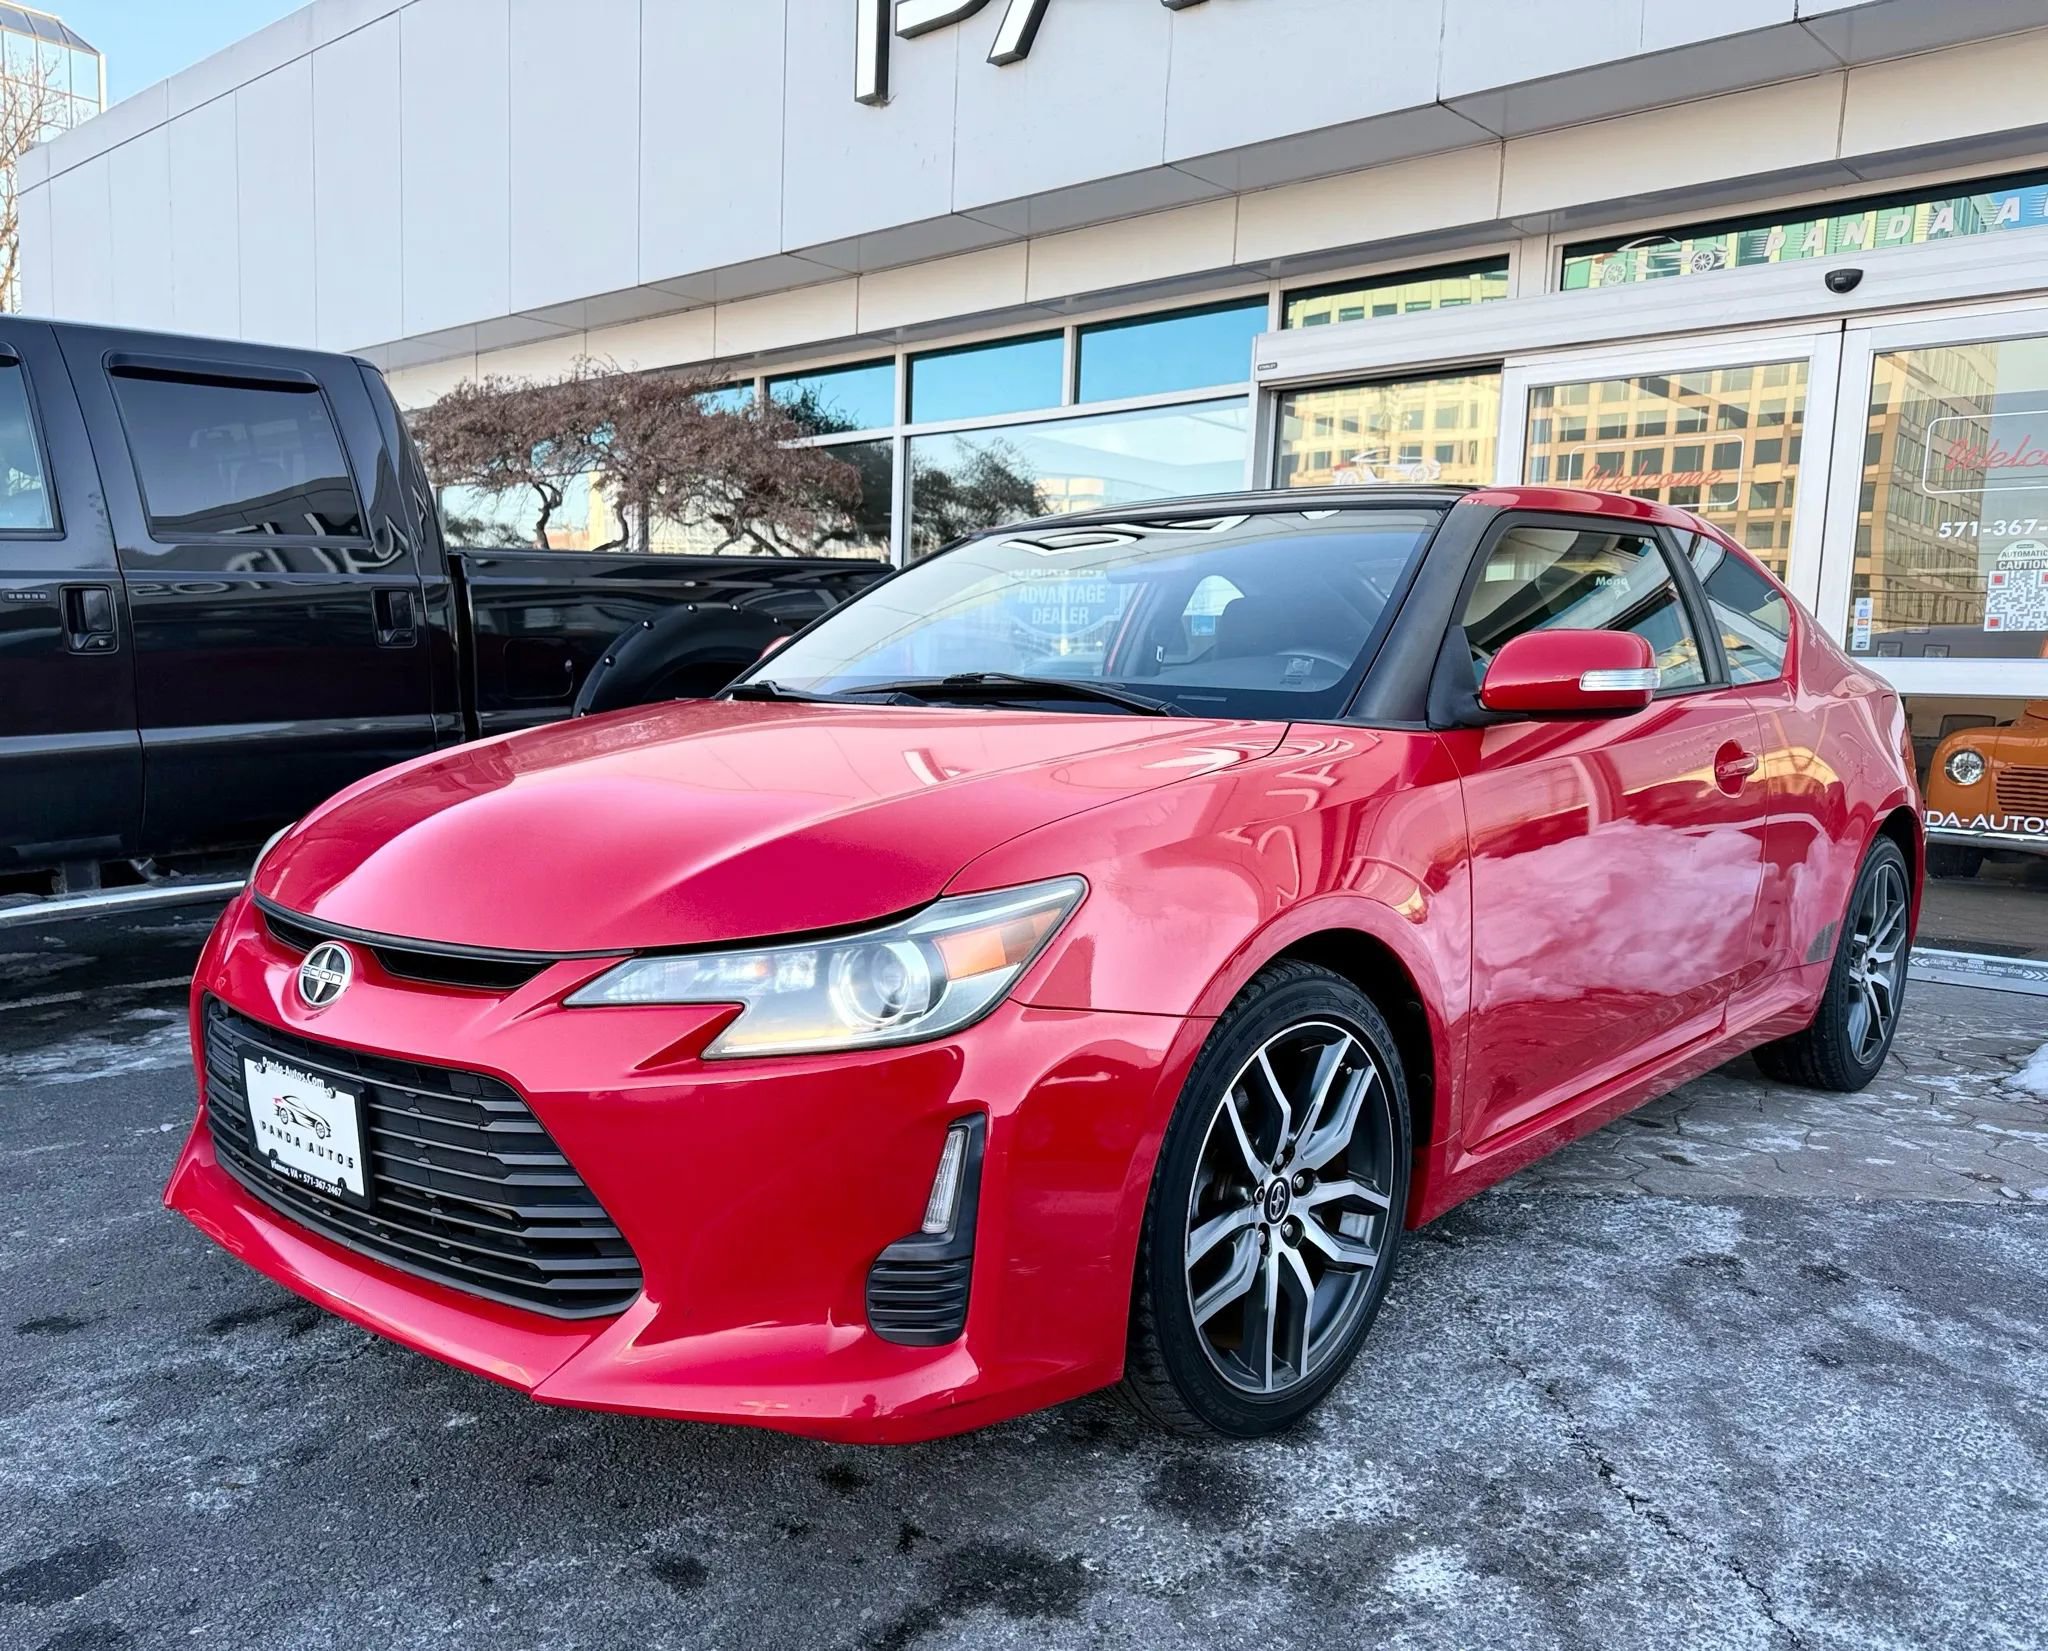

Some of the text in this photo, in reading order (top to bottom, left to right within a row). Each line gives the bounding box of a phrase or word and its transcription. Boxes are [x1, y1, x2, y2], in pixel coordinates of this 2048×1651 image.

[1763, 207, 1954, 257] PANDA
[1585, 460, 1722, 490] Welcome
[1018, 584, 1106, 603] ADVANTAGE
[1031, 607, 1089, 624] DEALER
[1923, 810, 2048, 833] DA-AUTO
[261, 1120, 354, 1169] PANDA AUTOS
